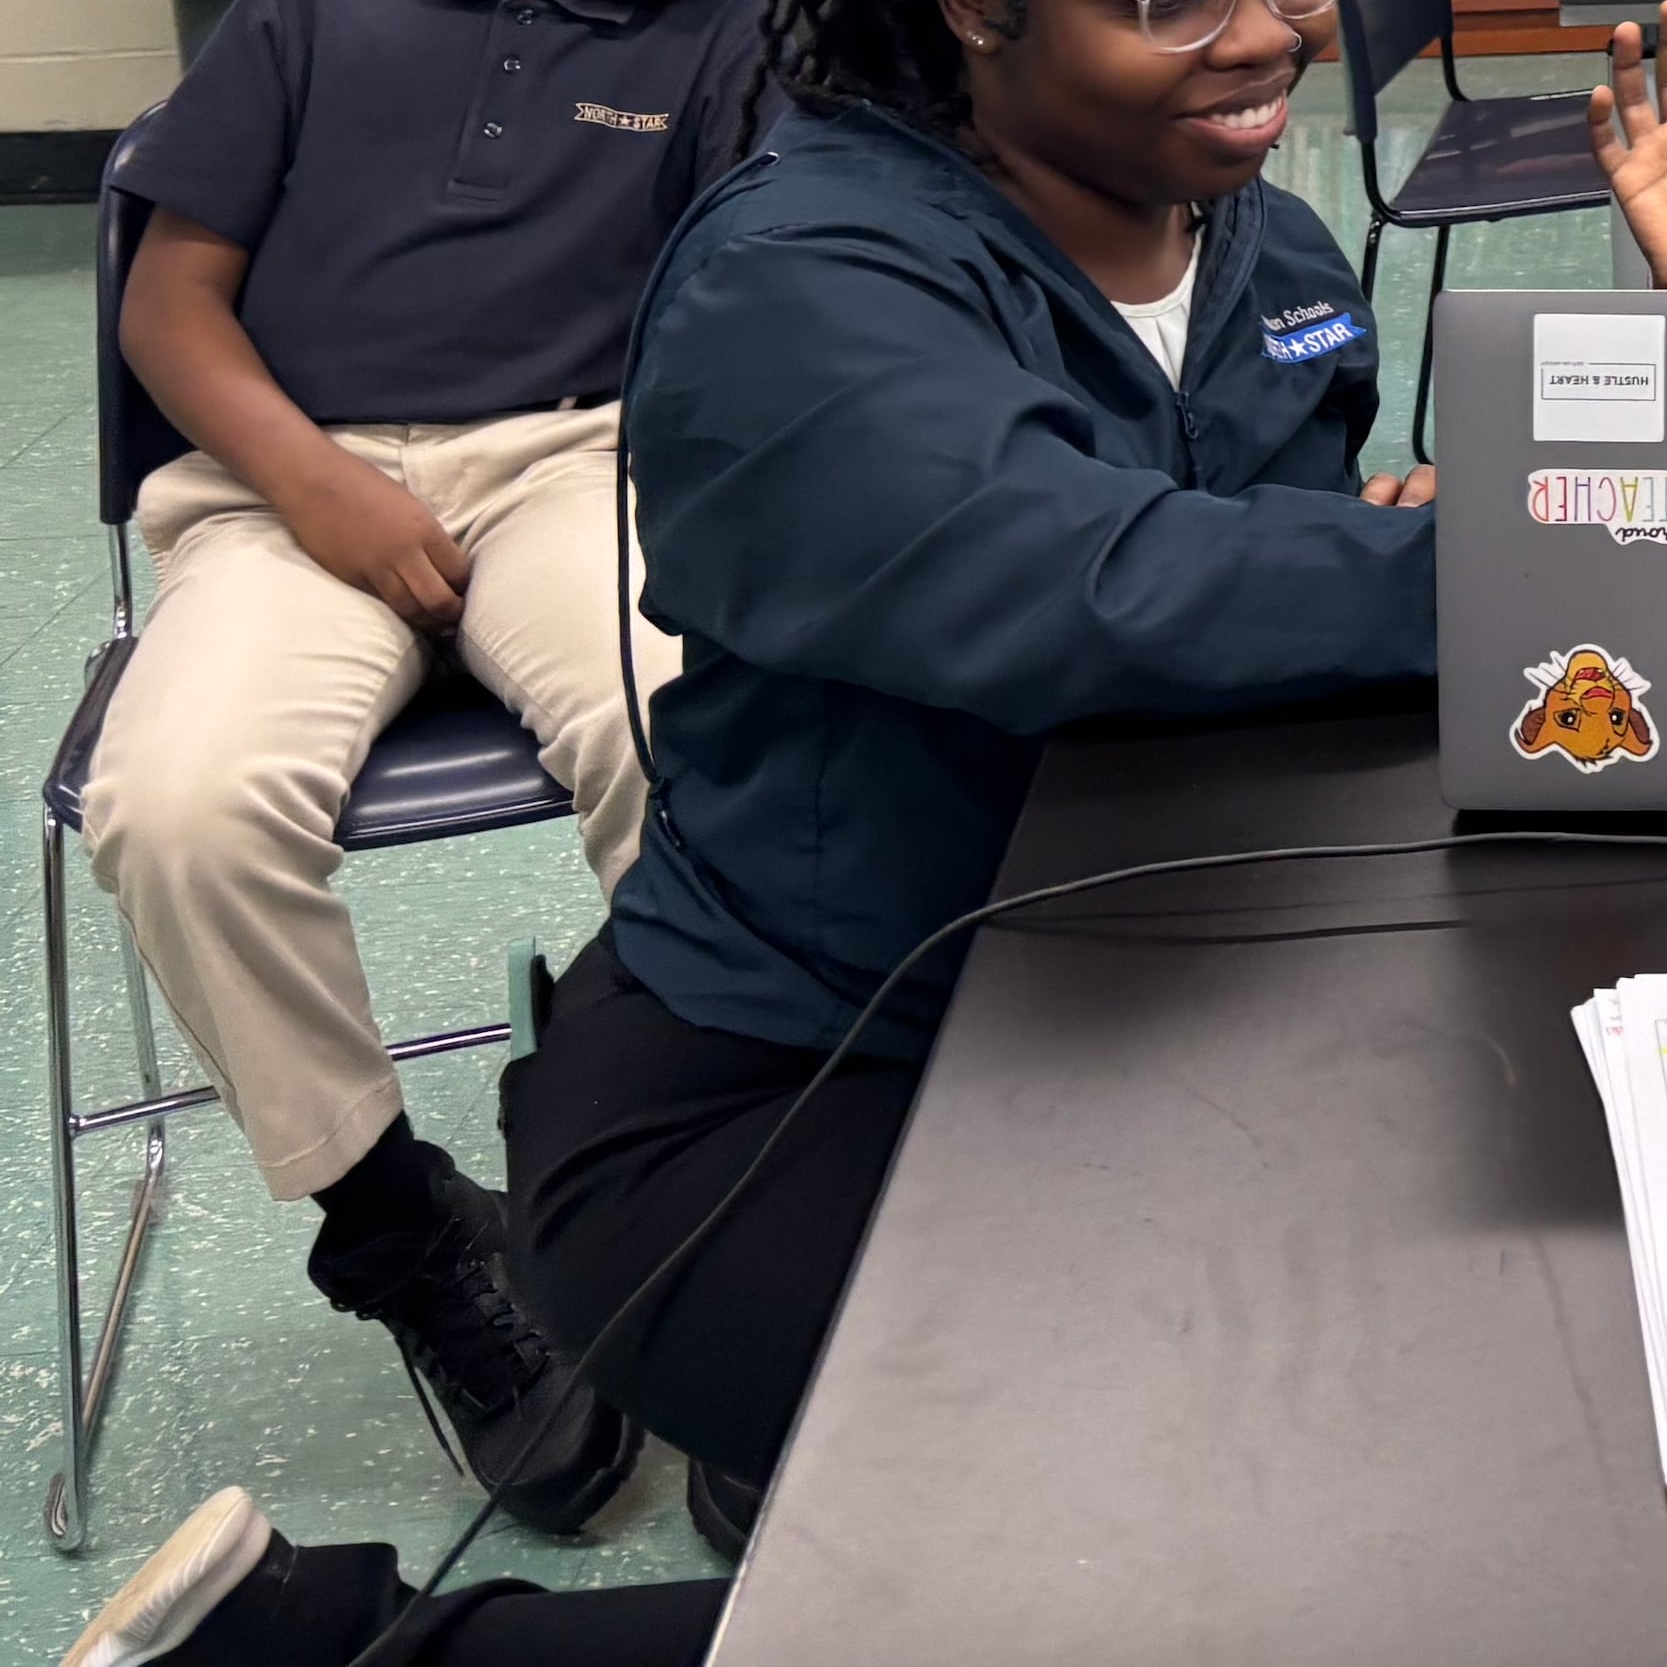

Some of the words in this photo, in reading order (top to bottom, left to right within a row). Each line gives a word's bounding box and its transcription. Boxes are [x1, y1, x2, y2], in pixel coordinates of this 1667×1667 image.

[584, 106, 618, 125] NORTH
[1284, 300, 1335, 327] Schools
[1305, 322, 1353, 353] STAR
[1550, 374, 1590, 386] HEART
[1605, 375, 1649, 386] HUSTLE
